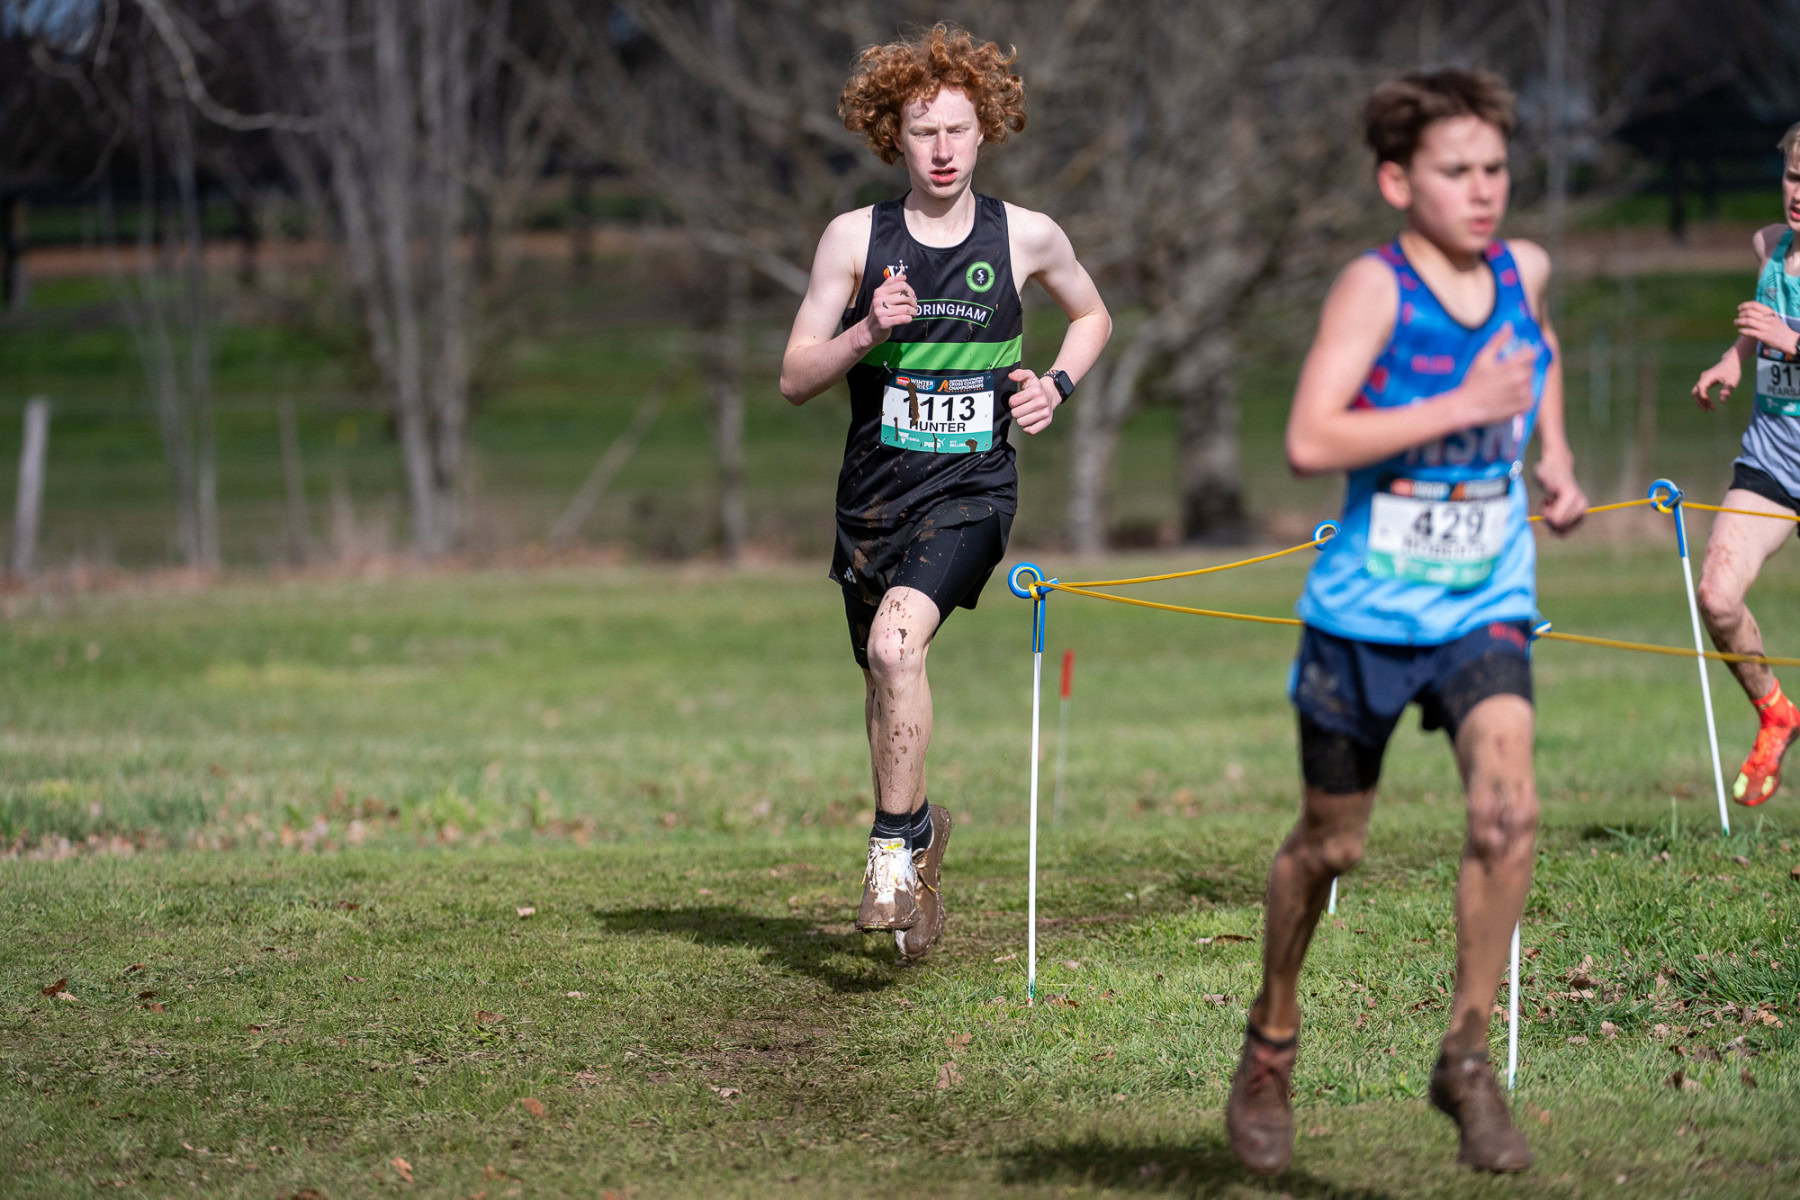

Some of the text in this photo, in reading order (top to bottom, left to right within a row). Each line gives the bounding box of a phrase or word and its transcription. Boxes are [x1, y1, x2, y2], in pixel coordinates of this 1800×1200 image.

[903, 396, 976, 422] 1113
[910, 421, 966, 432] HUNTER
[1412, 505, 1486, 541] 429
